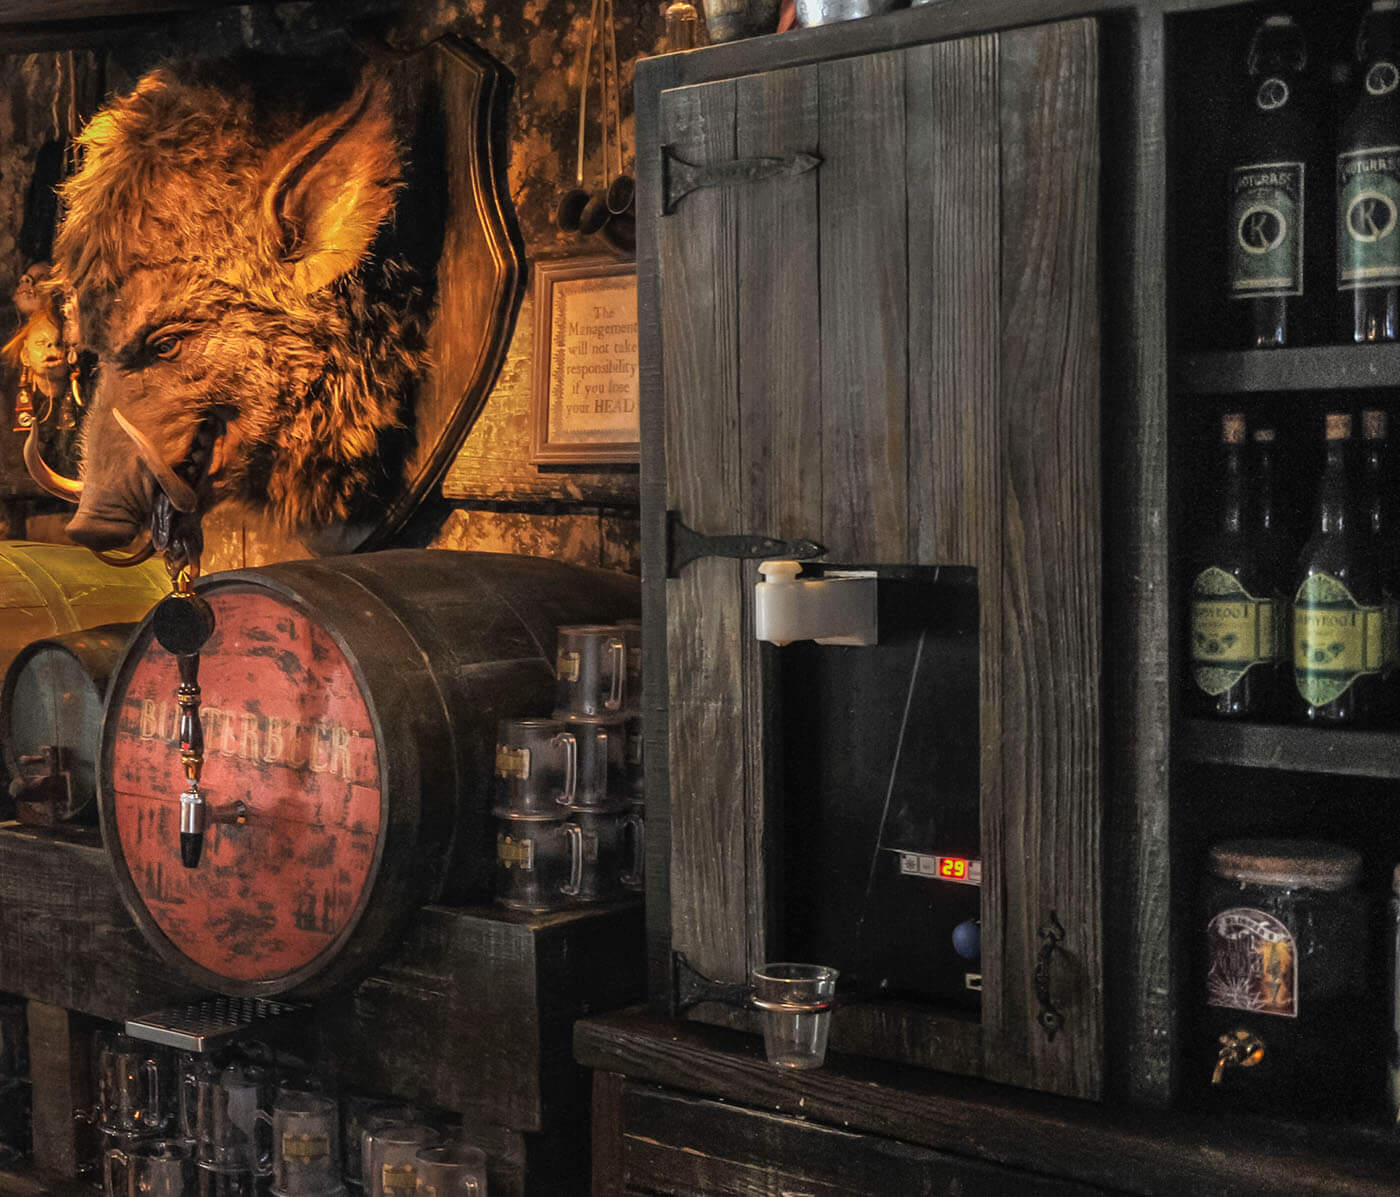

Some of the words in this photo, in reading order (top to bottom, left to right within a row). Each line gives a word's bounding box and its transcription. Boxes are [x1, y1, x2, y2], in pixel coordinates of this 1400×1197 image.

[593, 306, 615, 319] The
[568, 322, 637, 340] Management
[567, 342, 588, 355] will
[592, 345, 609, 354] not
[614, 339, 637, 353] take
[566, 359, 637, 379] responsibility
[572, 379, 581, 395] if
[585, 384, 605, 398] you
[608, 379, 631, 393] lose
[566, 404, 590, 420] your
[594, 399, 636, 413] HEAD
[140, 699, 351, 783] BUTERBEER
[942, 859, 965, 877] 29
